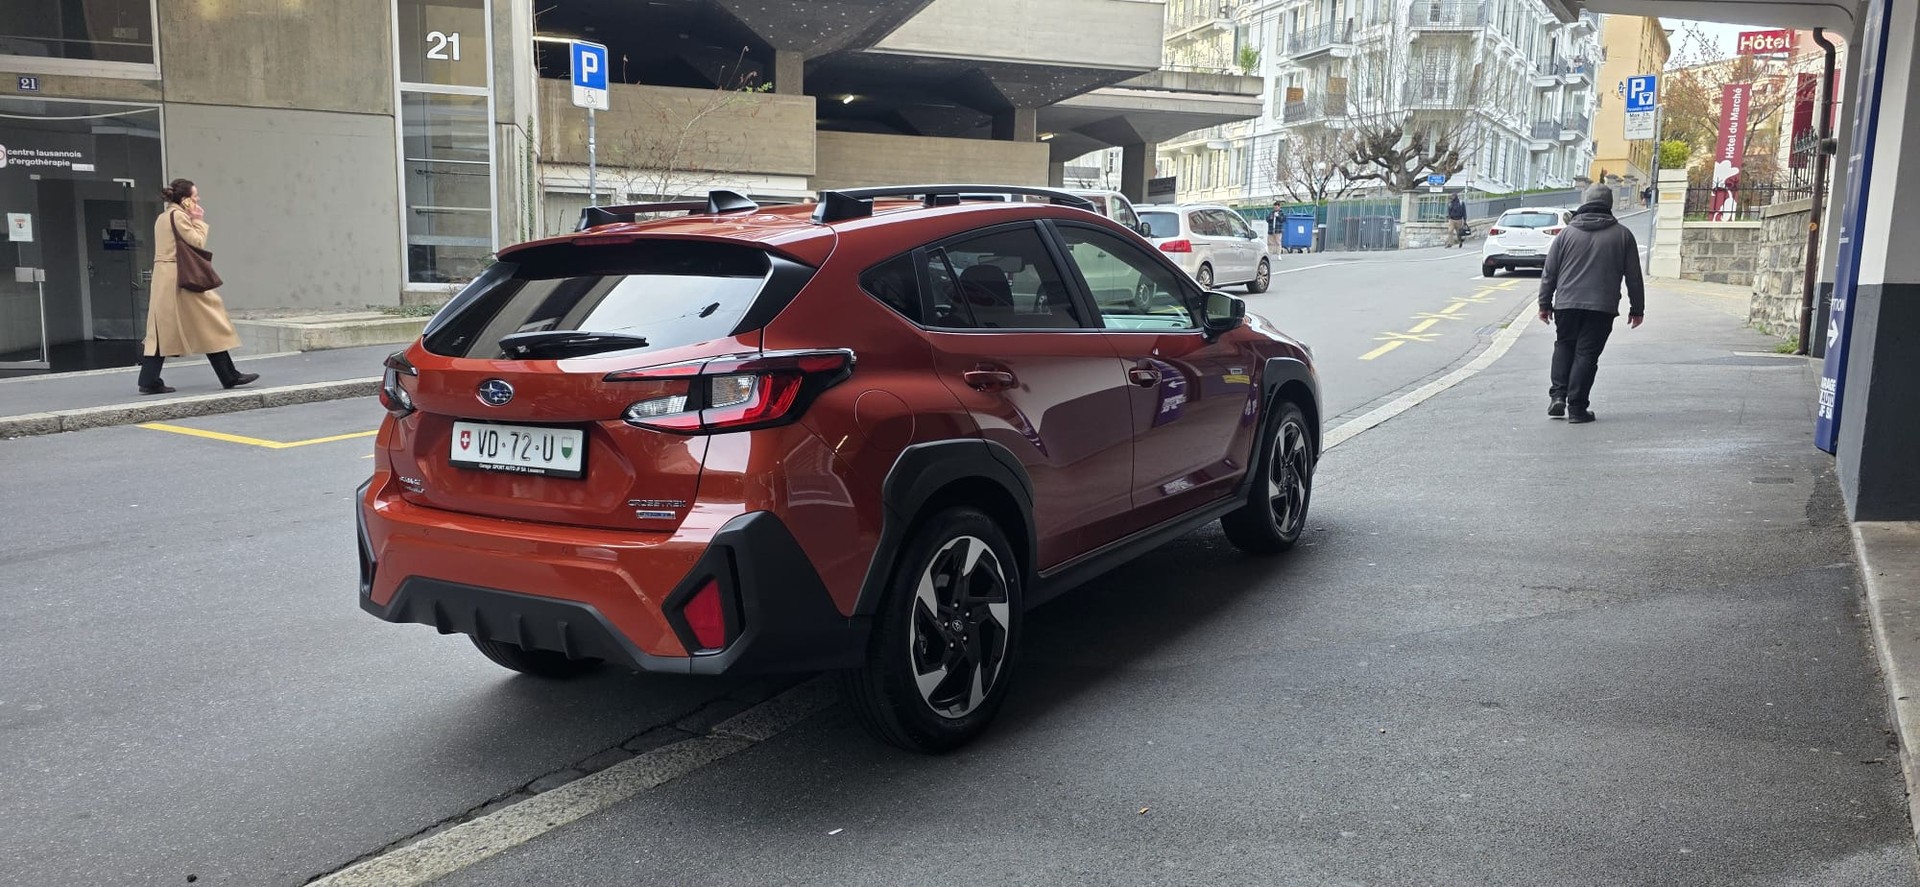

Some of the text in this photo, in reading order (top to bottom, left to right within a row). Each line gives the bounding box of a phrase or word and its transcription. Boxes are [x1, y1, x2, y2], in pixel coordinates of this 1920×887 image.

[426, 31, 460, 61] 21
[1740, 33, 1790, 51] Hôtel
[581, 51, 598, 83] P
[21, 78, 36, 90] 21
[1631, 78, 1646, 99] P
[1725, 87, 1743, 159] Hôtel du Marché
[8, 158, 70, 167] d'ergothérapie
[36, 149, 82, 158] lausannois
